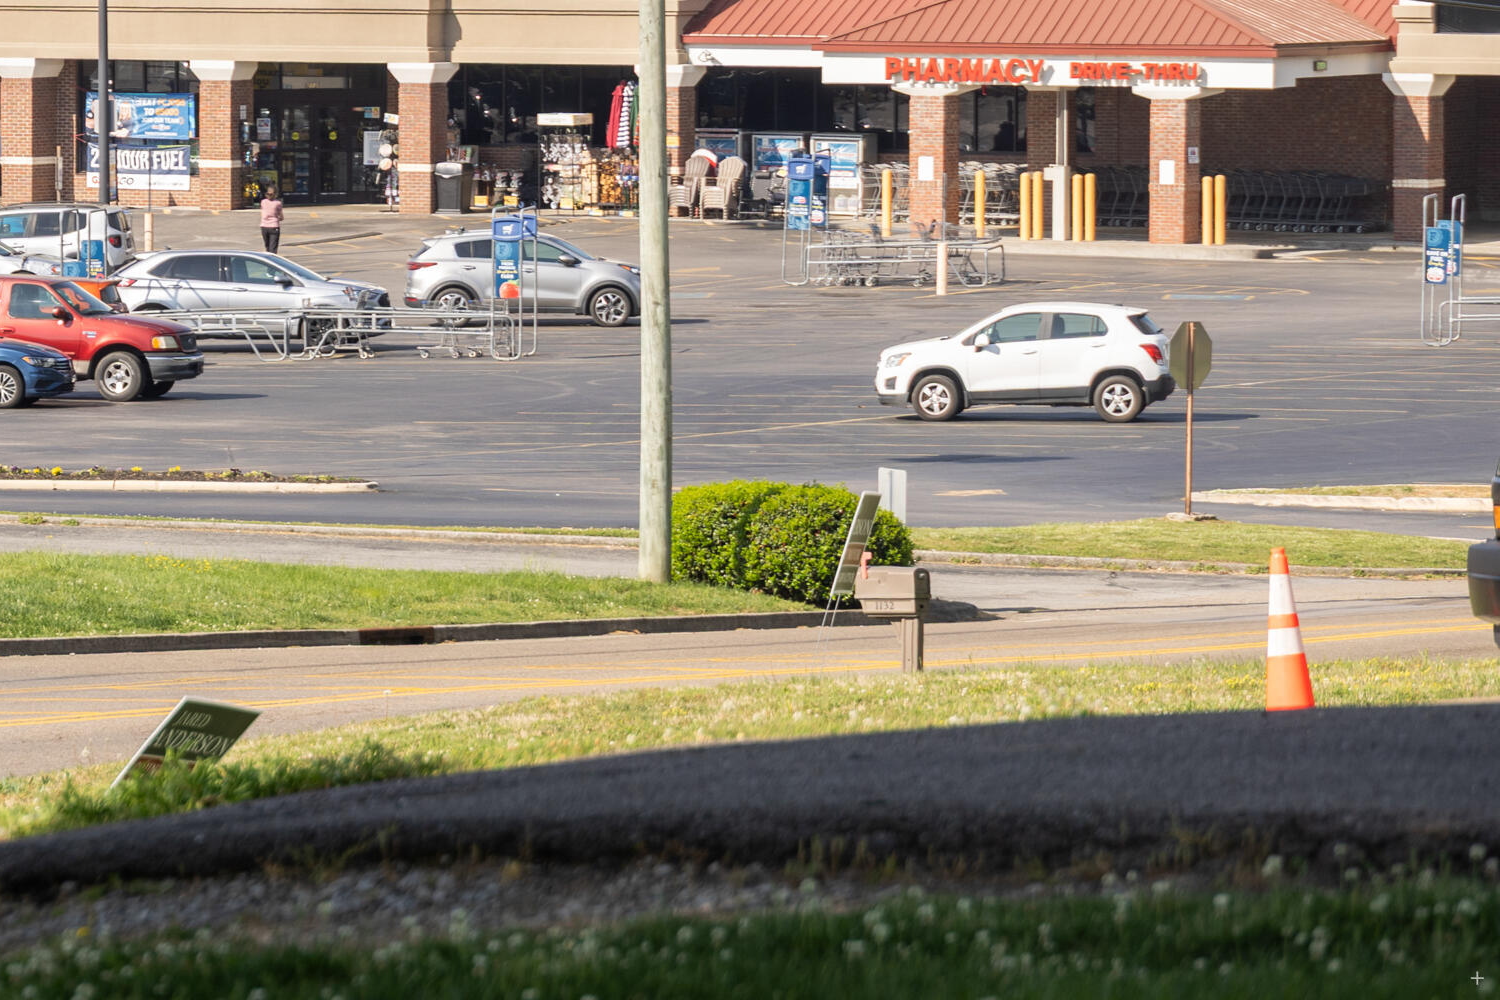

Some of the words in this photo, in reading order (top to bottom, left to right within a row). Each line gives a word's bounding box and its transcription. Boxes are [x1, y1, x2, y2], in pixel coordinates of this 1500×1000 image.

[885, 57, 1045, 83] PHARMACY
[1070, 62, 1199, 81] DRIVE-THRU
[90, 148, 100, 168] 2
[152, 150, 187, 171] FUEL
[171, 710, 212, 728] JARED
[153, 728, 233, 758] ANDERSON
